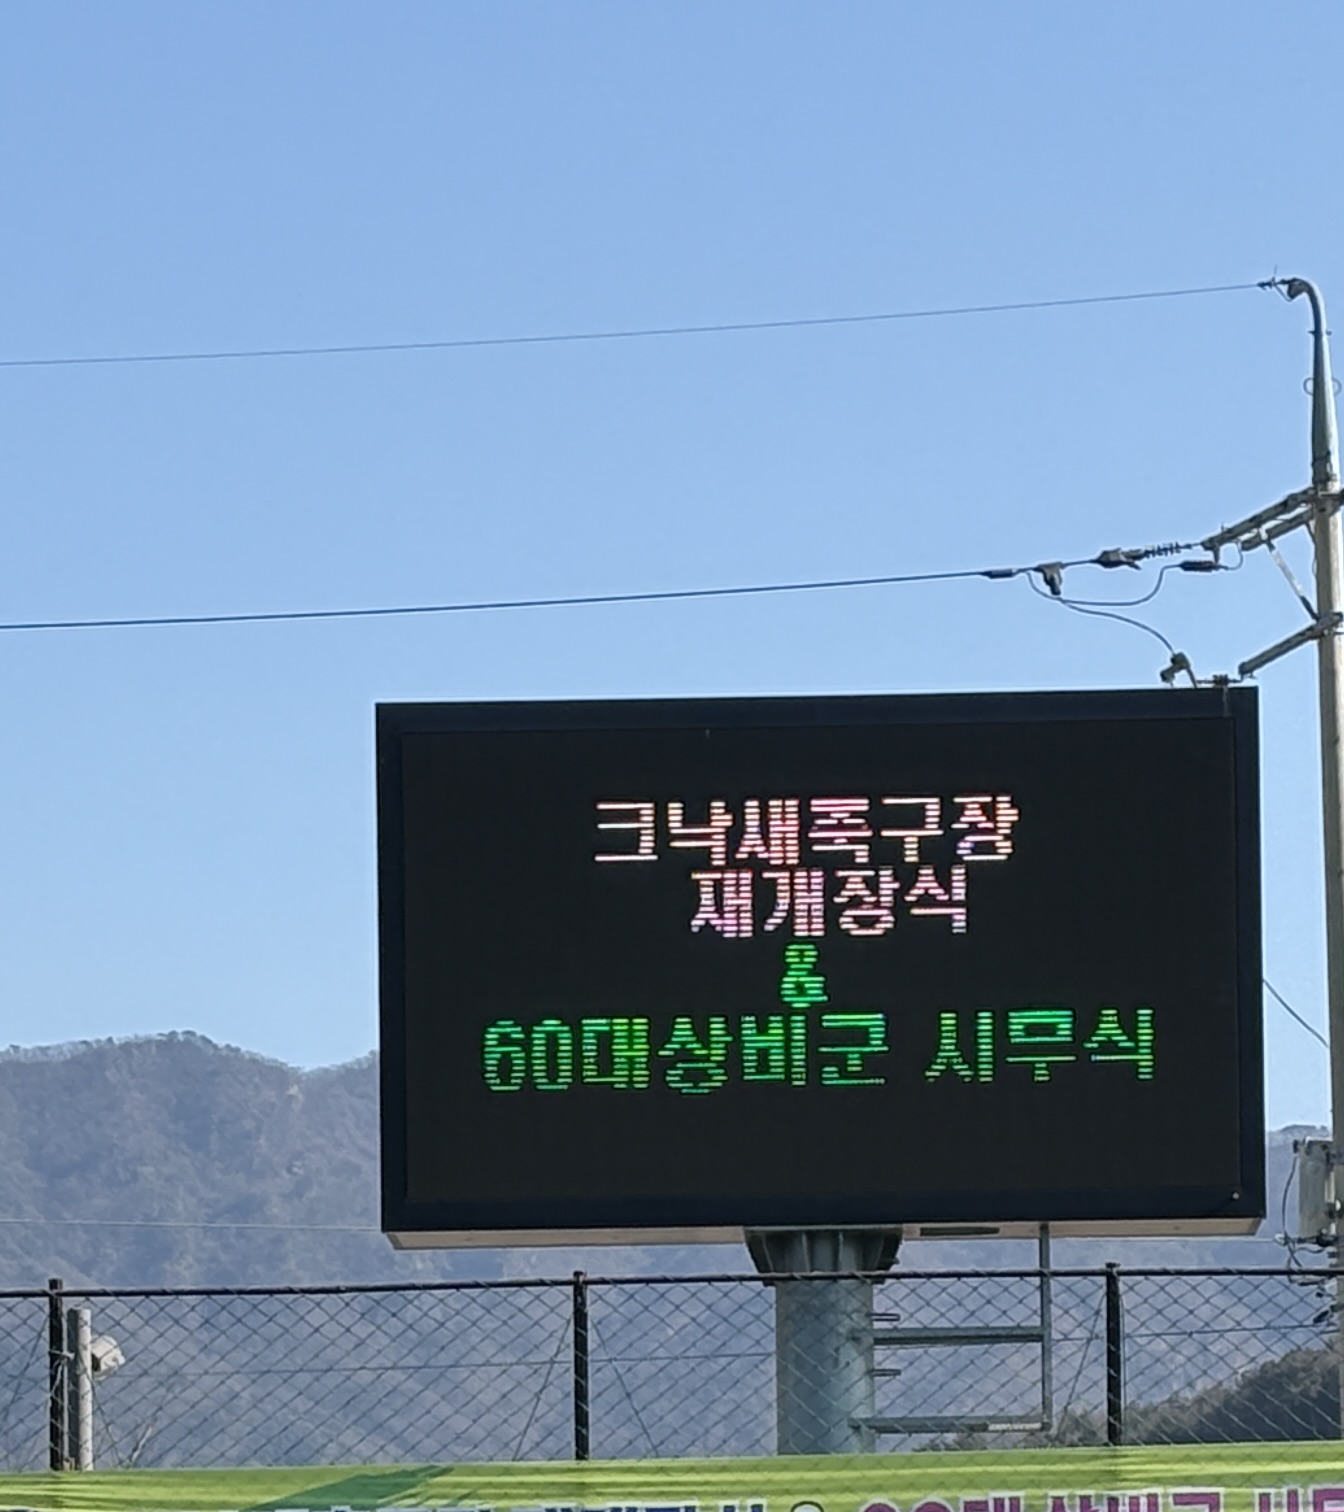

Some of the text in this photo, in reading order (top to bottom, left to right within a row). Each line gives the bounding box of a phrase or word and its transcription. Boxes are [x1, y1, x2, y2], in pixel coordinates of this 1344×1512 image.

[594, 795, 1020, 867] 크낙새축구장
[689, 865, 969, 938] 재개장식
[780, 943, 828, 1007] &
[482, 1008, 1155, 1094] 60대상비군 시무식
